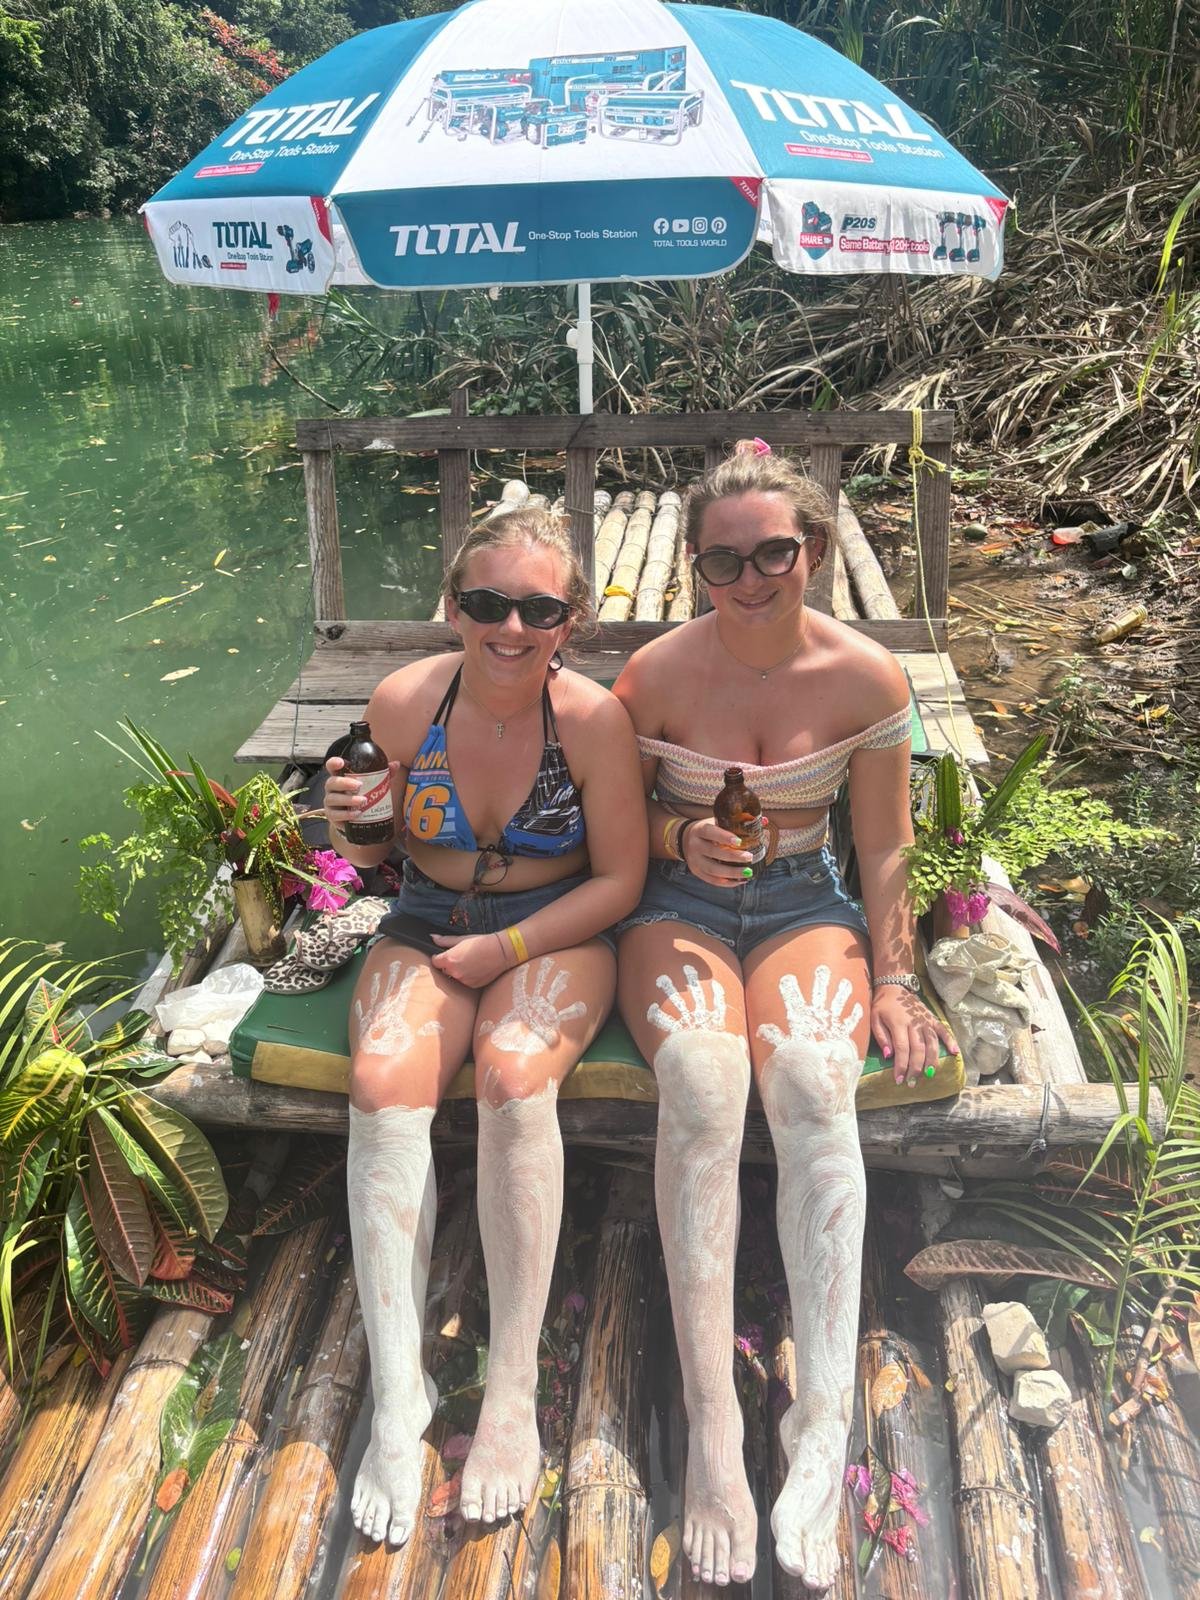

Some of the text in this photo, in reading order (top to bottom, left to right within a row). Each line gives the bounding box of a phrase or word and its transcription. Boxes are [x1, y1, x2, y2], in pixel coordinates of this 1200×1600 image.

[222, 92, 382, 148] TOTAL
[730, 79, 932, 142] TOTAL
[302, 142, 340, 155] Station
[800, 130, 945, 158] One-Stop Tools Station
[740, 180, 759, 202] TOTAL
[841, 216, 876, 231] P20S
[212, 221, 273, 249] TOTAL
[389, 221, 638, 256] TOTAL One-Stop Tools Station
[676, 239, 699, 247] TOOLS
[700, 239, 727, 247] WORLD
[801, 235, 823, 245] SHARE
[840, 238, 862, 250] Same
[910, 240, 930, 252] tools
